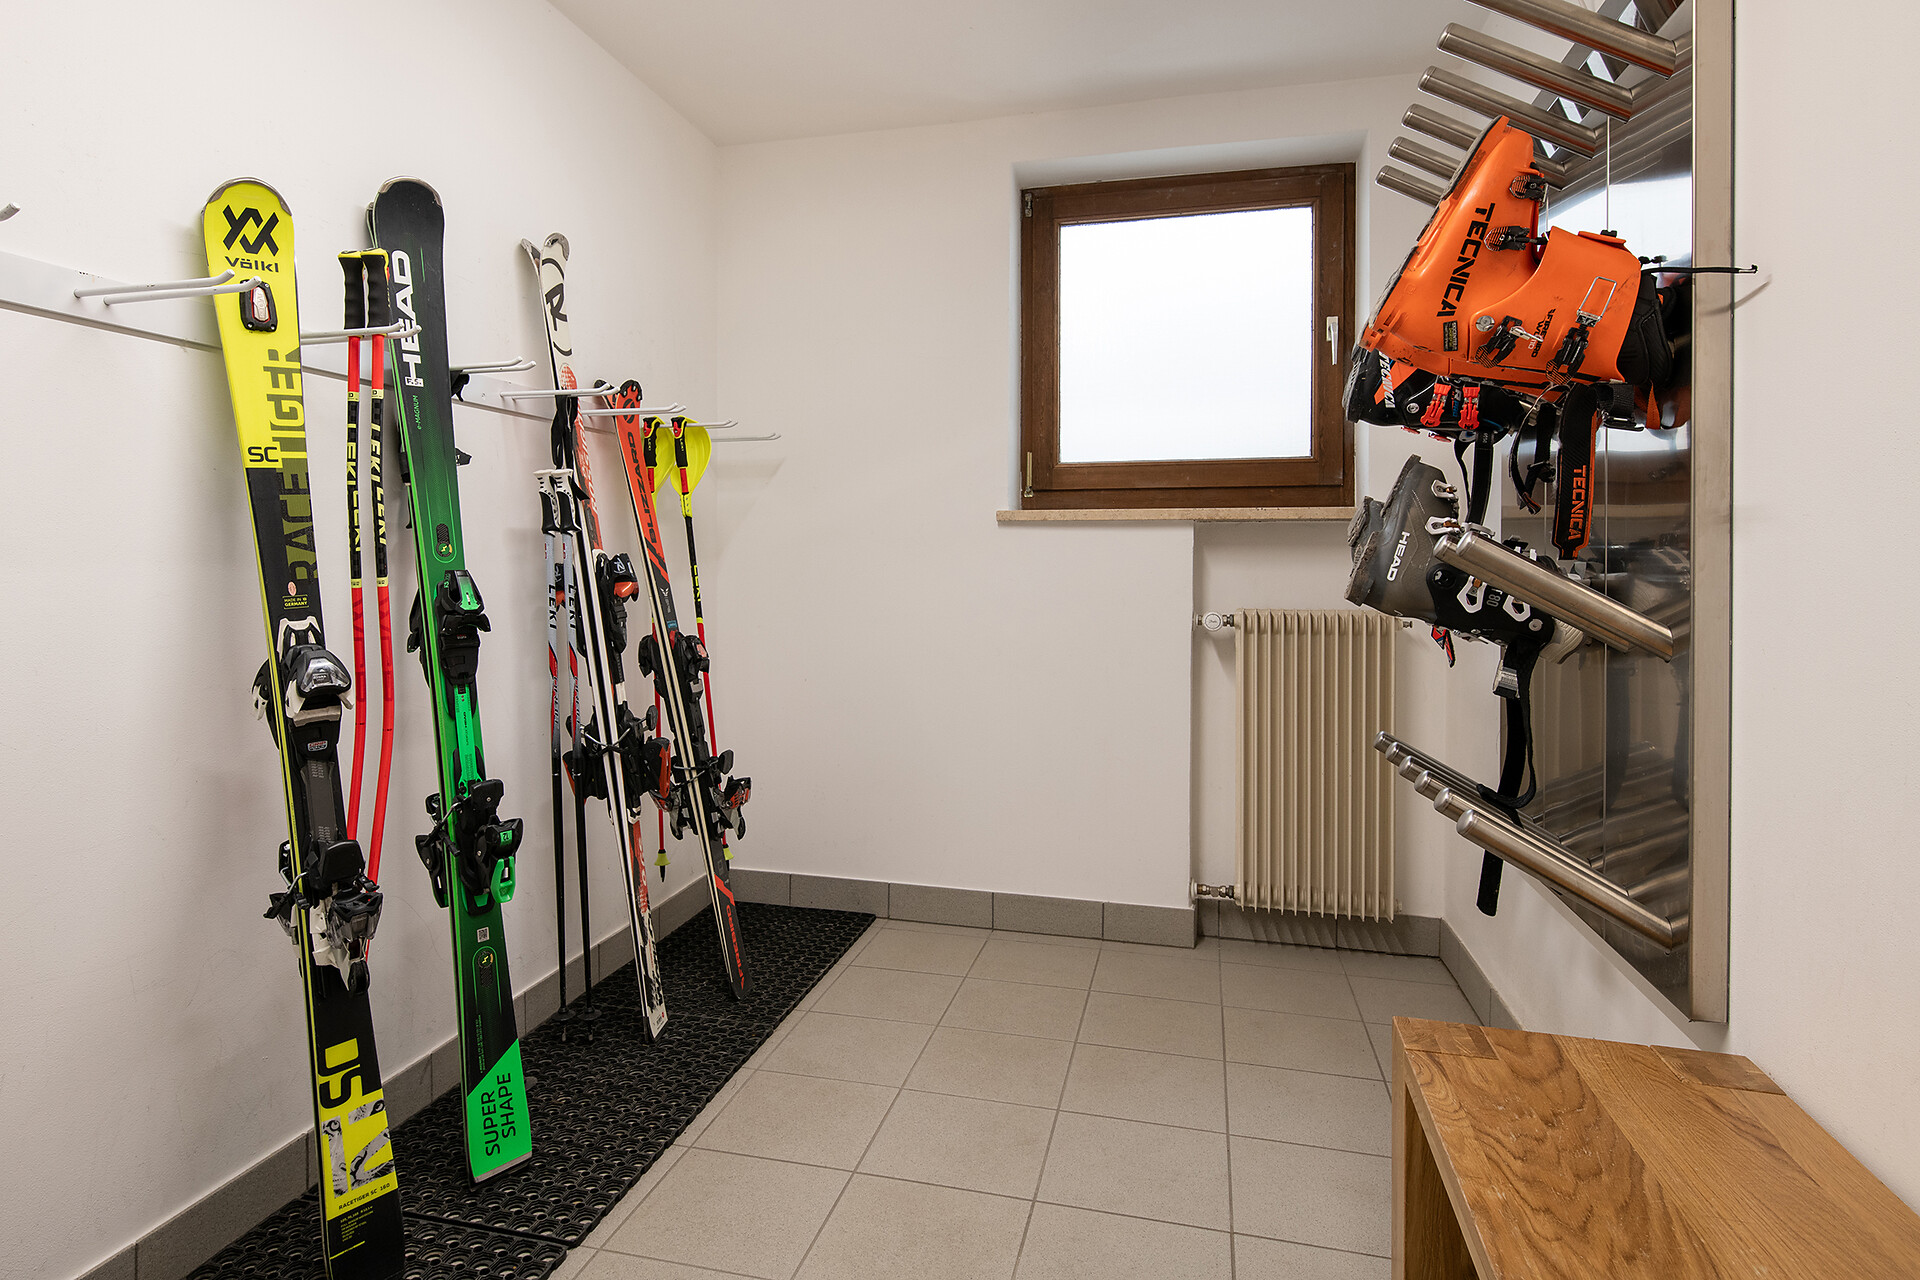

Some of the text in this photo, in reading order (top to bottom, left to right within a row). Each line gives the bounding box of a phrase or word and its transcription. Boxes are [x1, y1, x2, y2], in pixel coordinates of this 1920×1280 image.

[224, 255, 279, 273] Völkl
[1436, 202, 1496, 317] TECNICA
[391, 249, 424, 388] HEAD
[1378, 350, 1396, 409] TECNICA
[247, 446, 279, 463] SC
[627, 431, 657, 544] BLIZZARD
[1567, 464, 1587, 541] TECNICA
[1386, 530, 1411, 582] HEAD
[284, 600, 308, 608] GERMANY
[548, 583, 558, 630] LEKI
[567, 583, 577, 630] LEKI
[1486, 593, 1501, 608] 80
[725, 903, 745, 978] FIREBIRD
[480, 1090, 500, 1157] SUPER
[496, 1072, 517, 1137] SHAPE
[337, 1182, 391, 1211] RACETIGER SC 160
